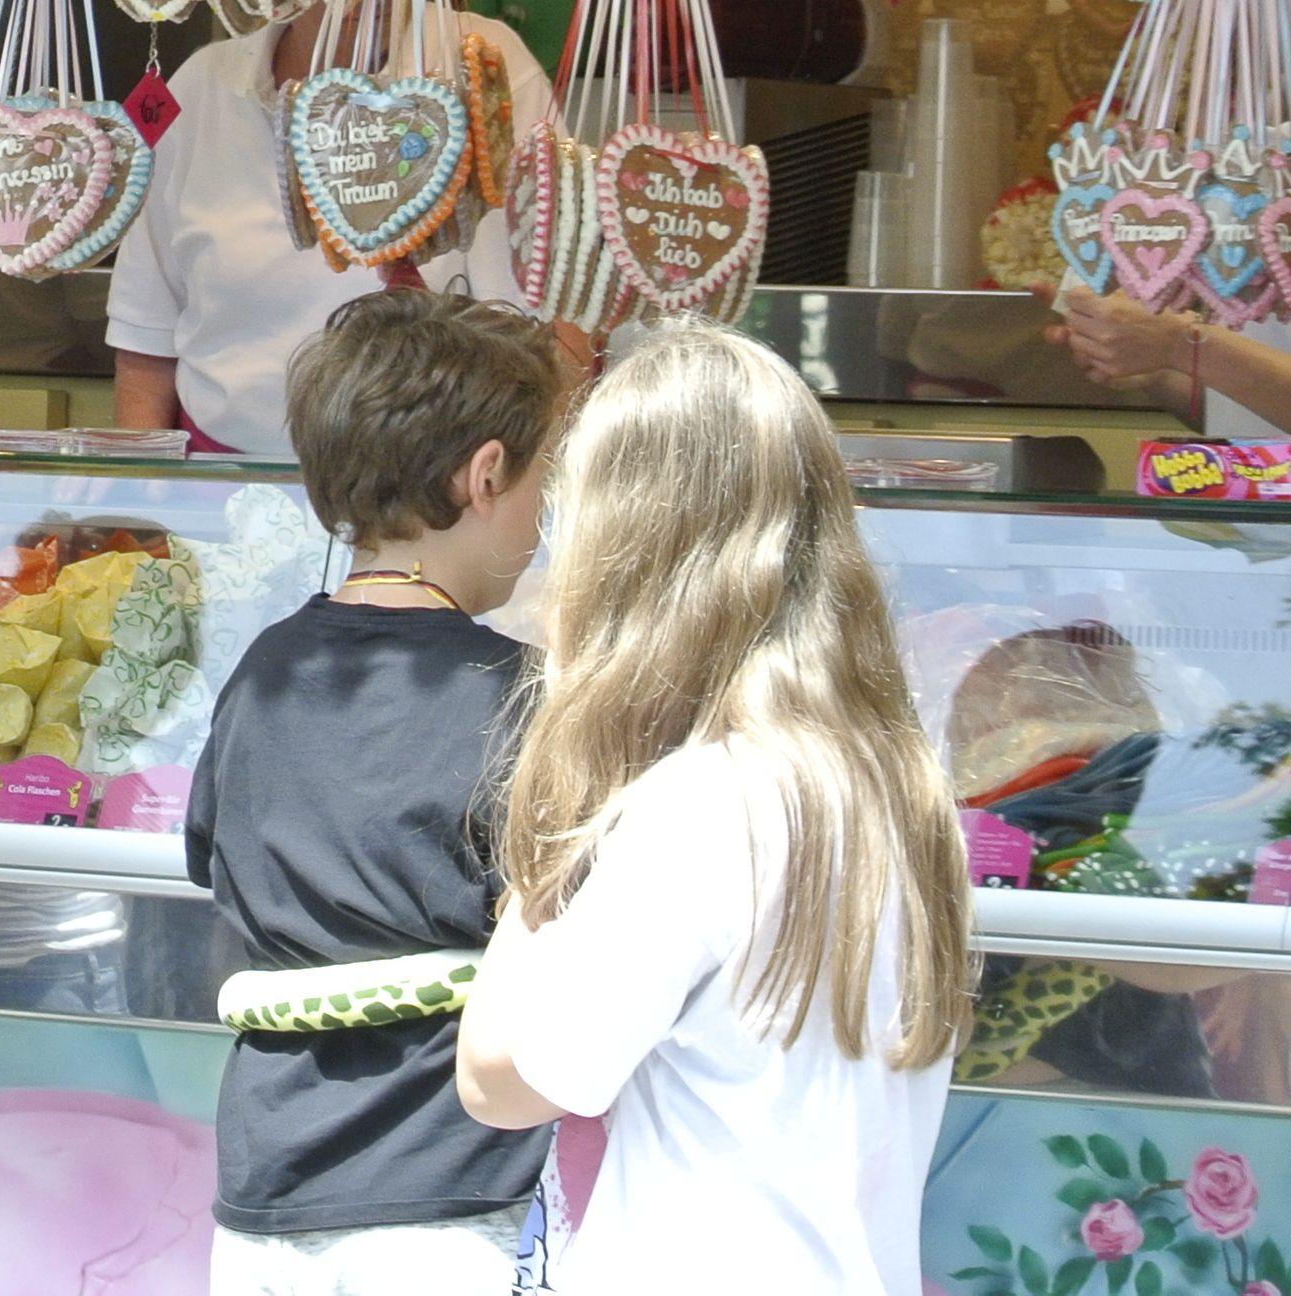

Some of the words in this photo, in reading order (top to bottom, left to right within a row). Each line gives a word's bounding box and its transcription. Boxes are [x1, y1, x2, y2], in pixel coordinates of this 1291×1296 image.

[329, 145, 377, 175] mein
[329, 178, 398, 205] Traum
[645, 172, 681, 203] Ich
[683, 176, 723, 208] hab
[651, 210, 703, 239] Dich
[8, 783, 27, 796] Cola
[28, 785, 61, 798] Flaschen
